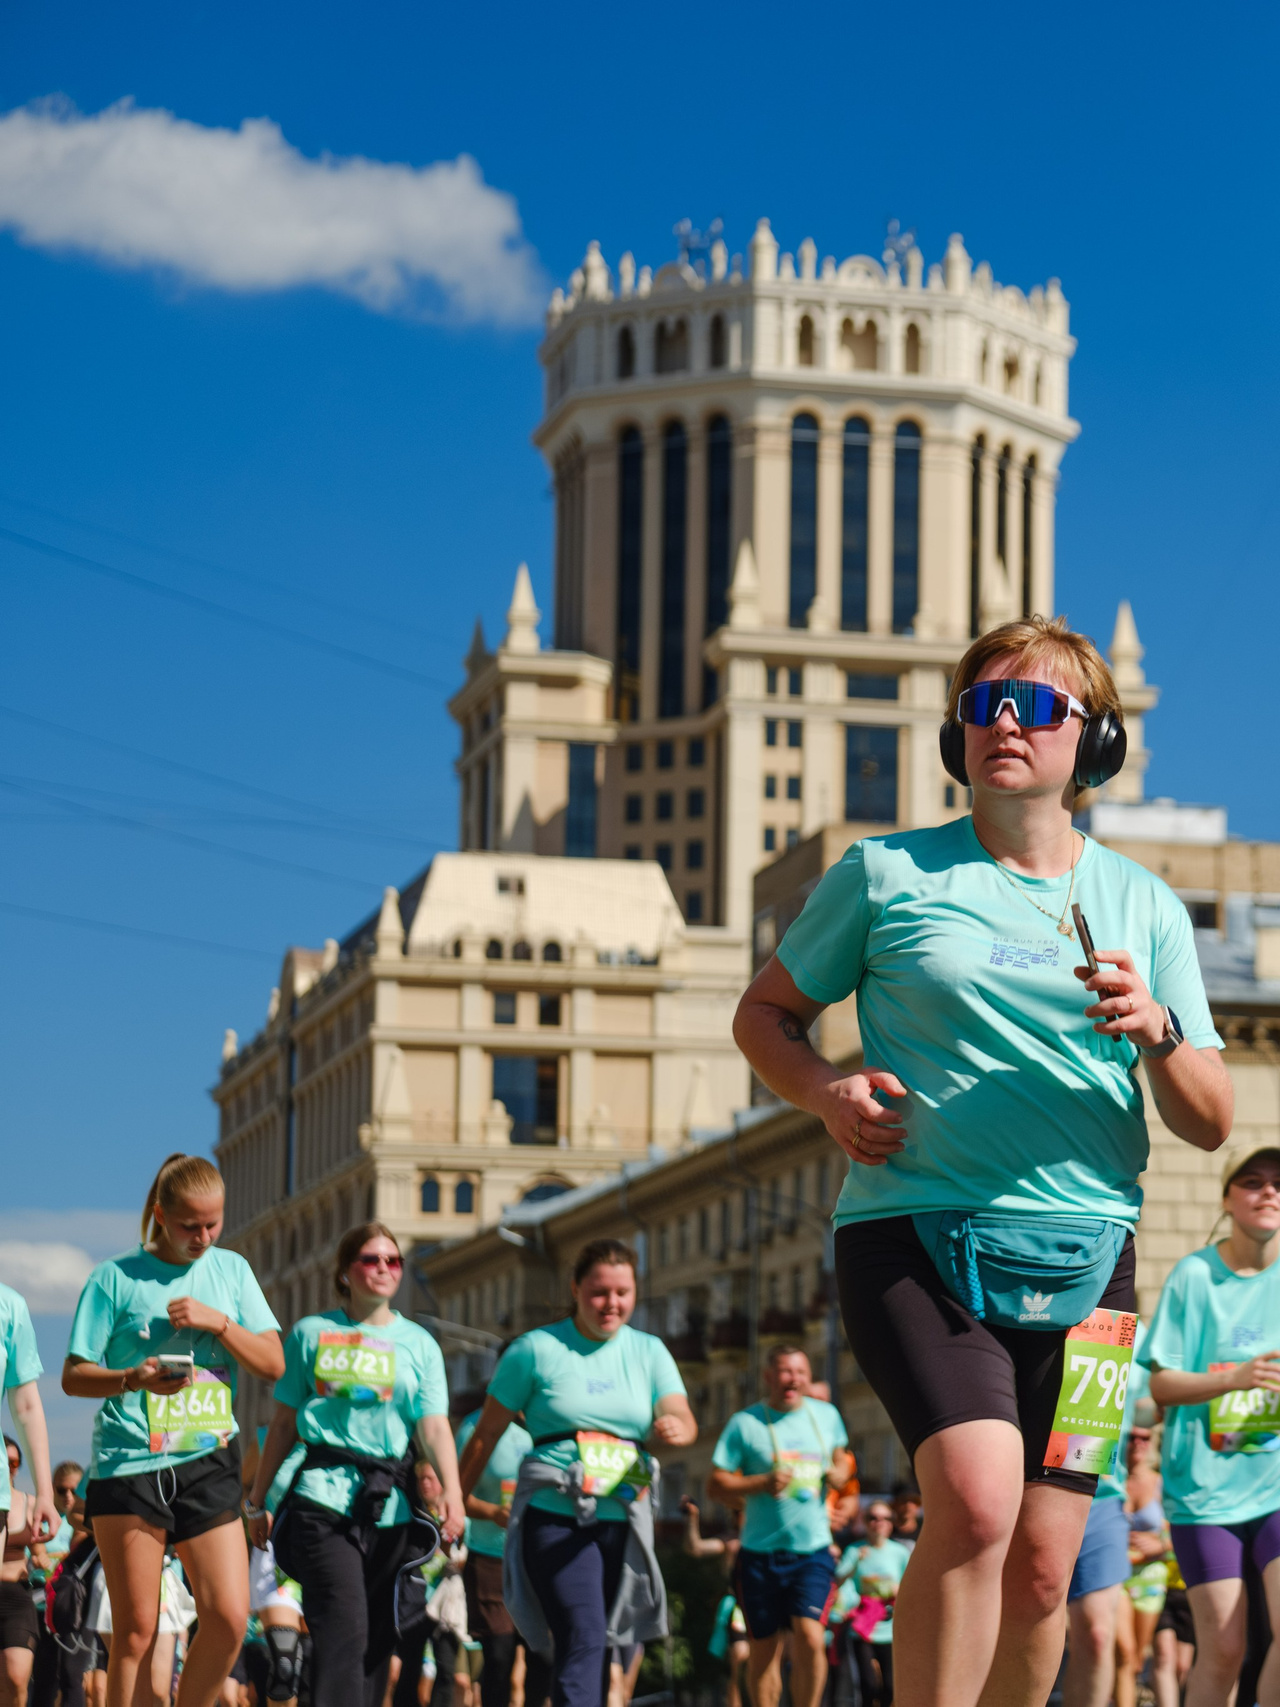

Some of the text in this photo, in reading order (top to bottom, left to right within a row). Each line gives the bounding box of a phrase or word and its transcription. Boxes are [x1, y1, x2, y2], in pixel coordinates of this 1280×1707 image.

[1019, 1312, 1051, 1321] adidas
[1076, 1321, 1113, 1332] 3/08
[319, 1348, 390, 1376] 66721
[1070, 1354, 1130, 1411] 798
[151, 1388, 227, 1419] 73641
[1062, 1416, 1118, 1430] ФЕСТИВАЛЬ
